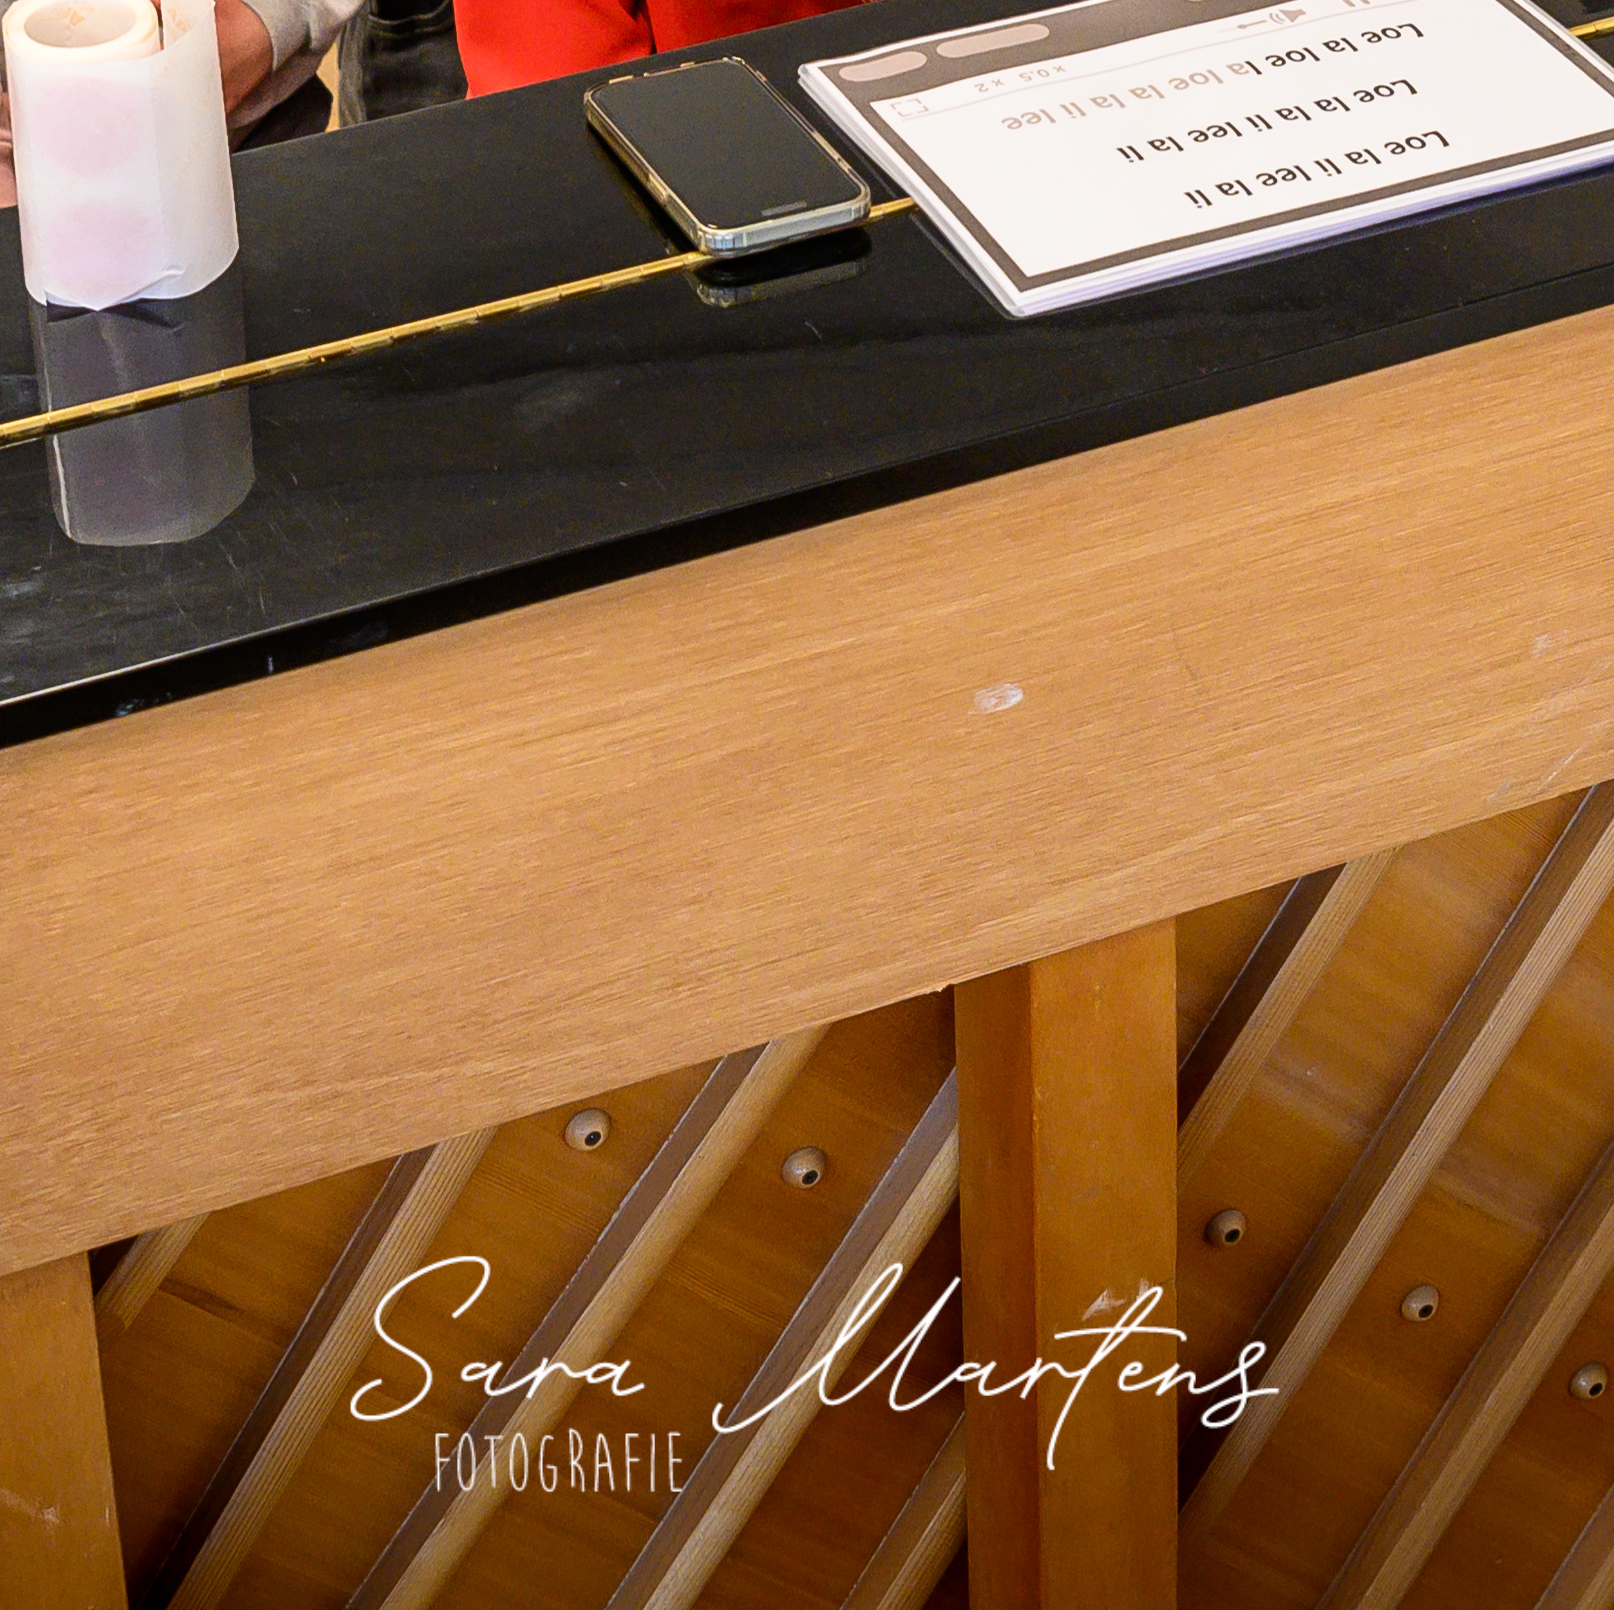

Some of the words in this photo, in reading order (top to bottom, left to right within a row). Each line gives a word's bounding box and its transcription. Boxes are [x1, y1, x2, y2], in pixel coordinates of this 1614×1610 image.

[1360, 22, 1425, 44] Loe
[1321, 37, 1359, 53] la
[1264, 46, 1321, 68] loe
[1225, 60, 1263, 76] la
[1167, 69, 1224, 91] loe
[1089, 93, 1126, 109] la
[1127, 84, 1165, 100] la
[1352, 78, 1418, 104] Loe
[1059, 101, 1087, 119] li
[1273, 105, 1313, 122] la
[1312, 95, 1352, 113] la
[1000, 108, 1057, 130] lee
[1244, 113, 1274, 133] li
[1186, 121, 1244, 144] lee
[1146, 135, 1185, 153] la
[1383, 130, 1451, 157] Loe
[1115, 144, 1145, 164] li
[1343, 147, 1383, 166] la
[1255, 164, 1313, 187] lee
[1313, 157, 1343, 179] li
[1213, 179, 1254, 197] la
[1183, 188, 1214, 209] li
